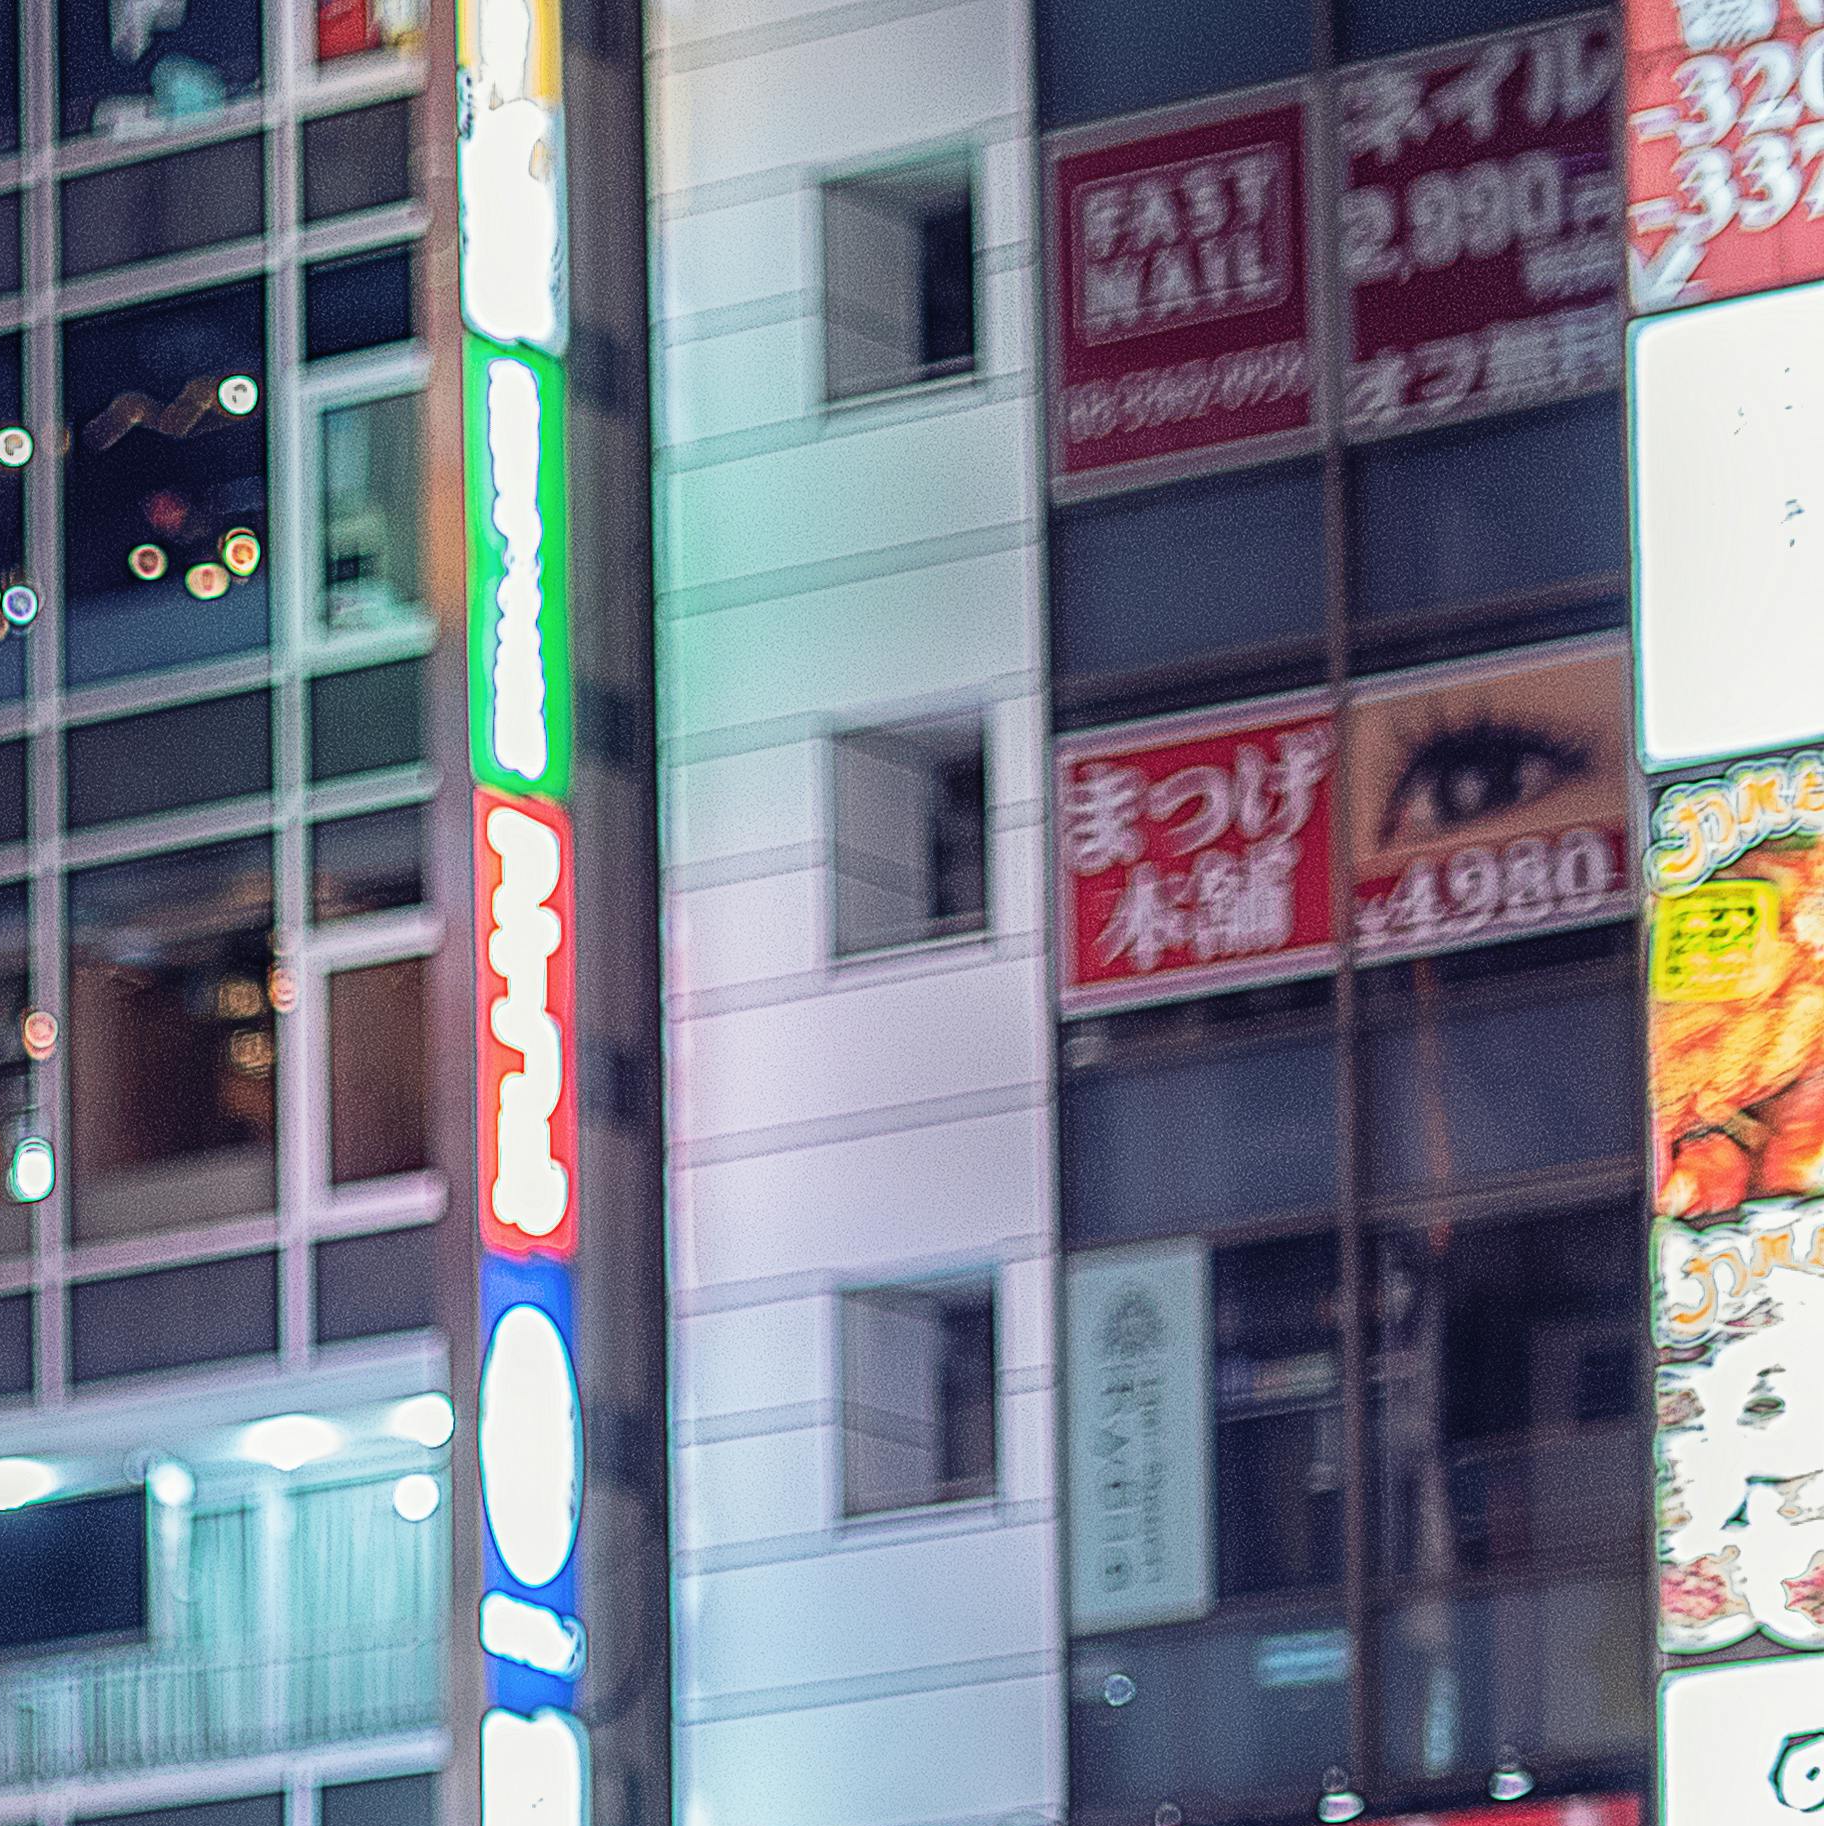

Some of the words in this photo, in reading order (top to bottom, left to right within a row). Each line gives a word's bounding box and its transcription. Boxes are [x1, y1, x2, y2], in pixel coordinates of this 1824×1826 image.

[1066, 726, 1332, 871] まつげ
[1095, 842, 1296, 971] 本舗
